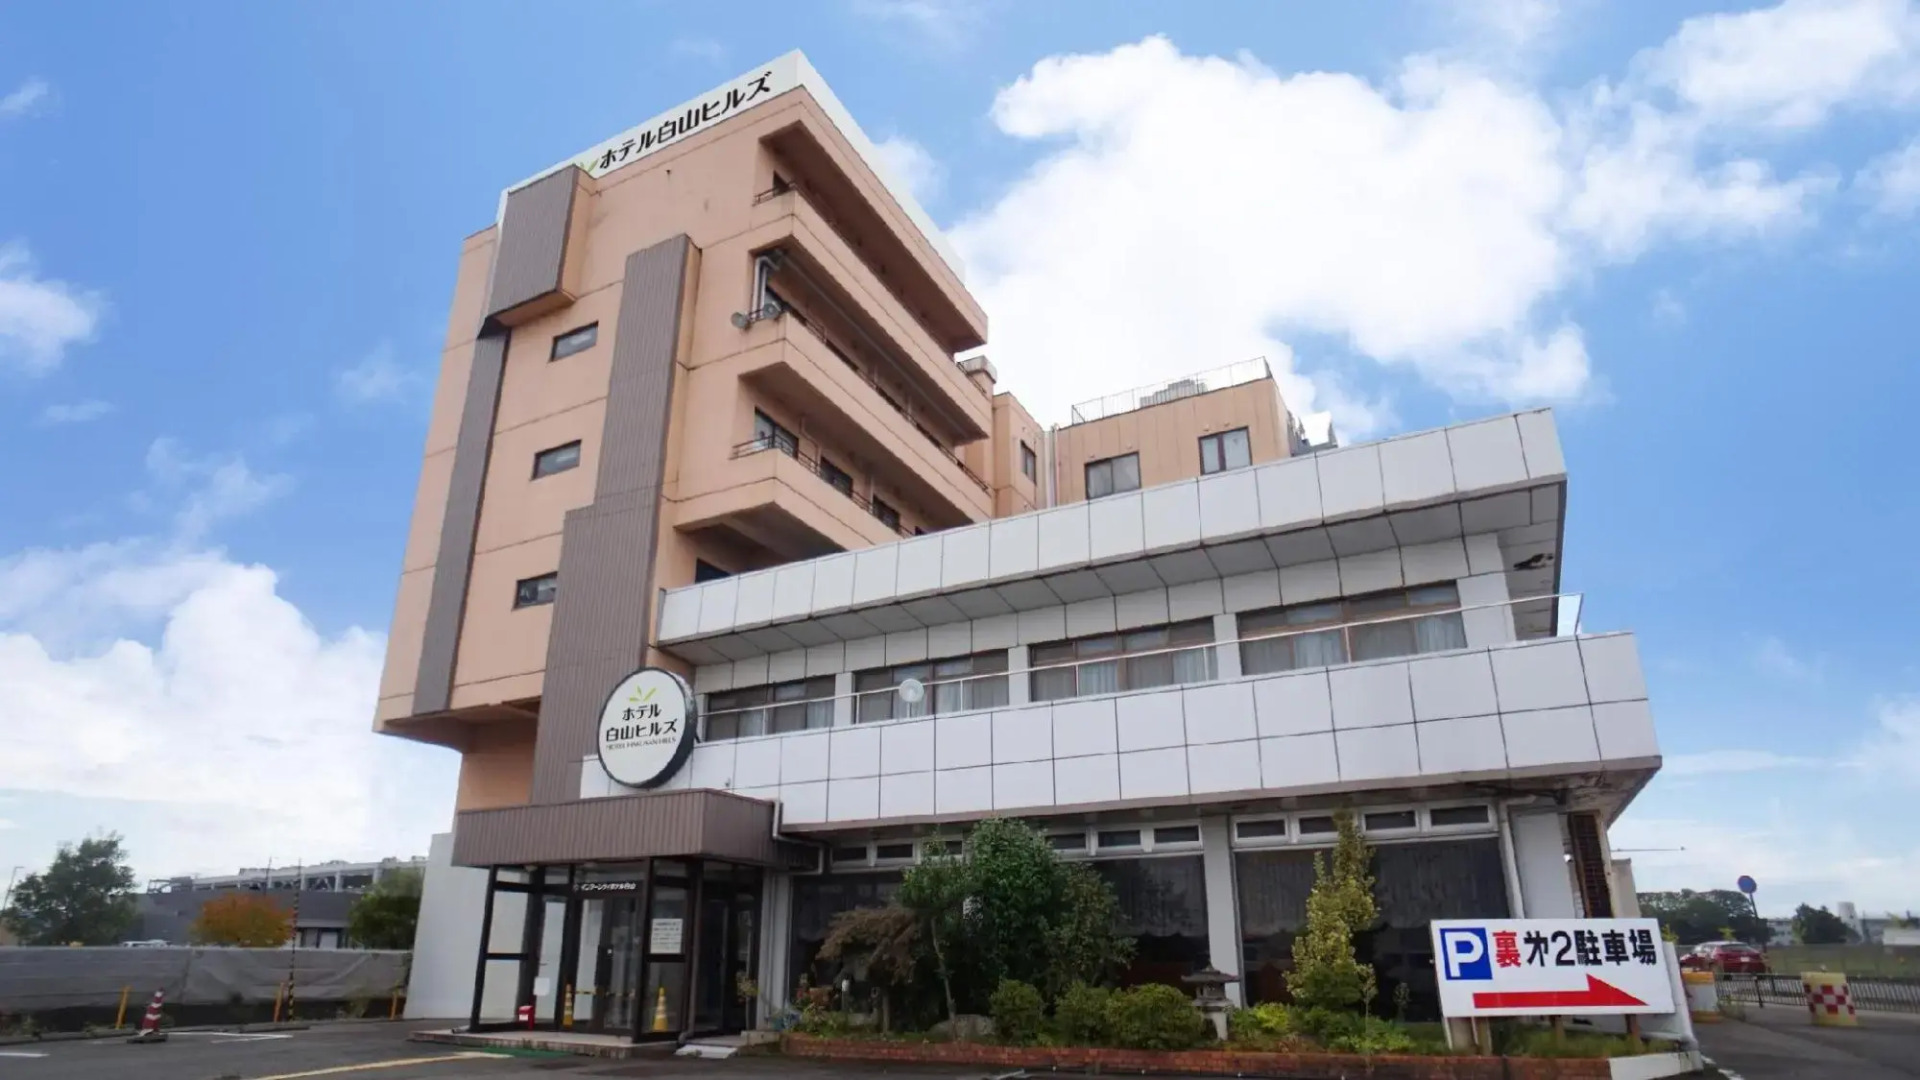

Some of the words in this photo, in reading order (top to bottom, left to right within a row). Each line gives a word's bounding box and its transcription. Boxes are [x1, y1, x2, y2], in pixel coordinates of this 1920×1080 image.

[600, 71, 772, 169] ホテル白山ヒルズ
[622, 703, 662, 721] ホテル
[606, 718, 678, 742] 白山ヒルズ
[1445, 931, 1483, 977] P
